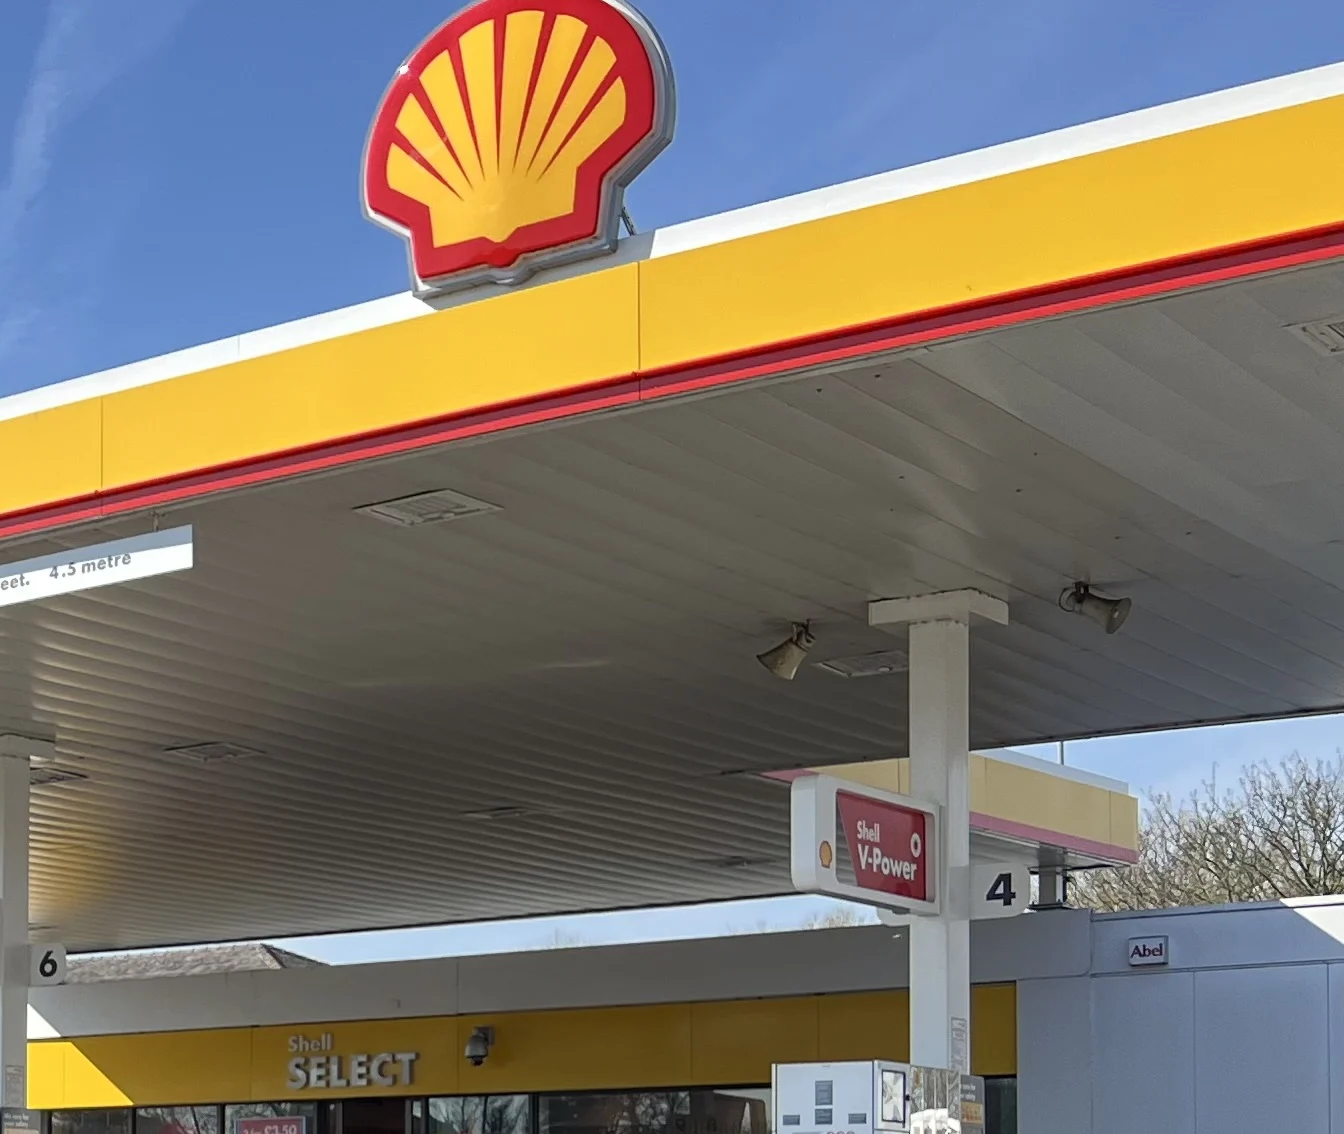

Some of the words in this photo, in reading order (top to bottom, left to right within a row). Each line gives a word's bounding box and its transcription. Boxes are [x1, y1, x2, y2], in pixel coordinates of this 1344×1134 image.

[49, 561, 77, 580] 4.5
[81, 553, 132, 574] metre
[856, 819, 880, 843] Shell
[857, 843, 917, 881] V-Power
[985, 872, 1016, 907] 4
[38, 950, 58, 978] 6
[1130, 942, 1163, 959] Abel
[287, 1032, 333, 1052] Shell
[287, 1052, 417, 1090] SELECT
